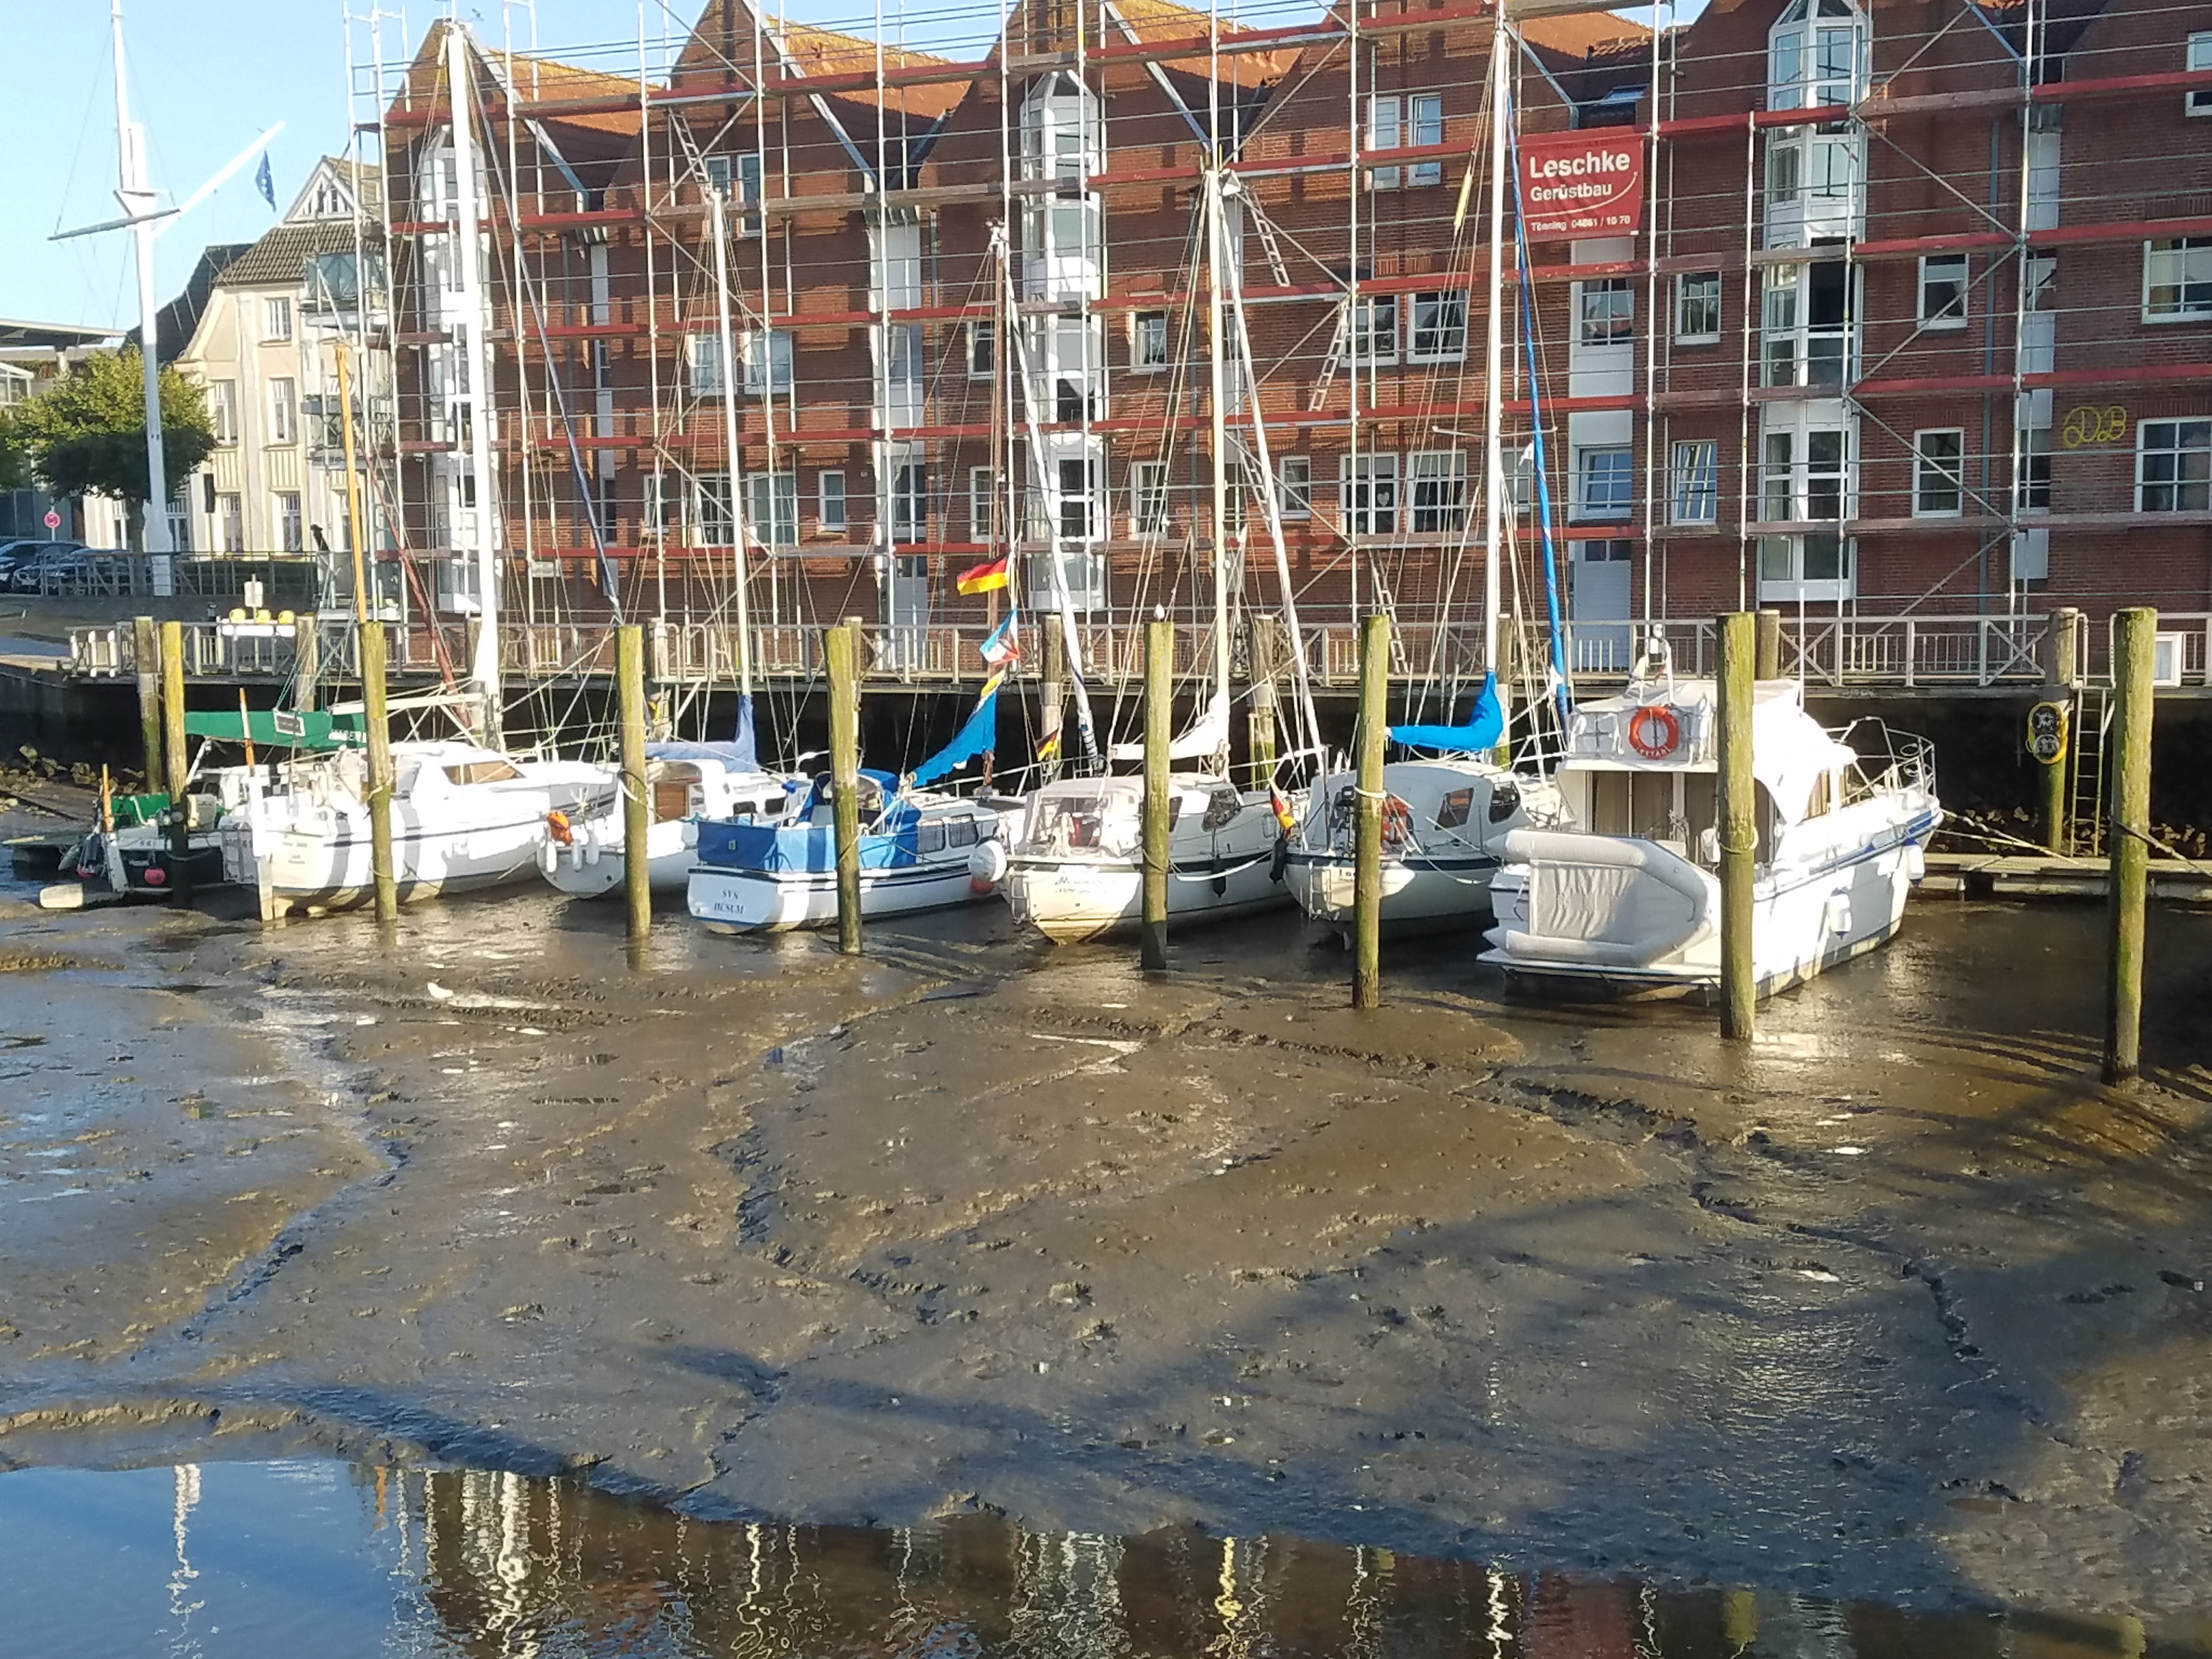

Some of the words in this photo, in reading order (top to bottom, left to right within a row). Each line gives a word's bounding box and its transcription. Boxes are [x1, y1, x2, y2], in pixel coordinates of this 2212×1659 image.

[1530, 150, 1630, 178] Leschke
[1530, 183, 1612, 201] Gerüstbau
[1606, 216, 1617, 225] 10
[1620, 215, 1630, 225] 70
